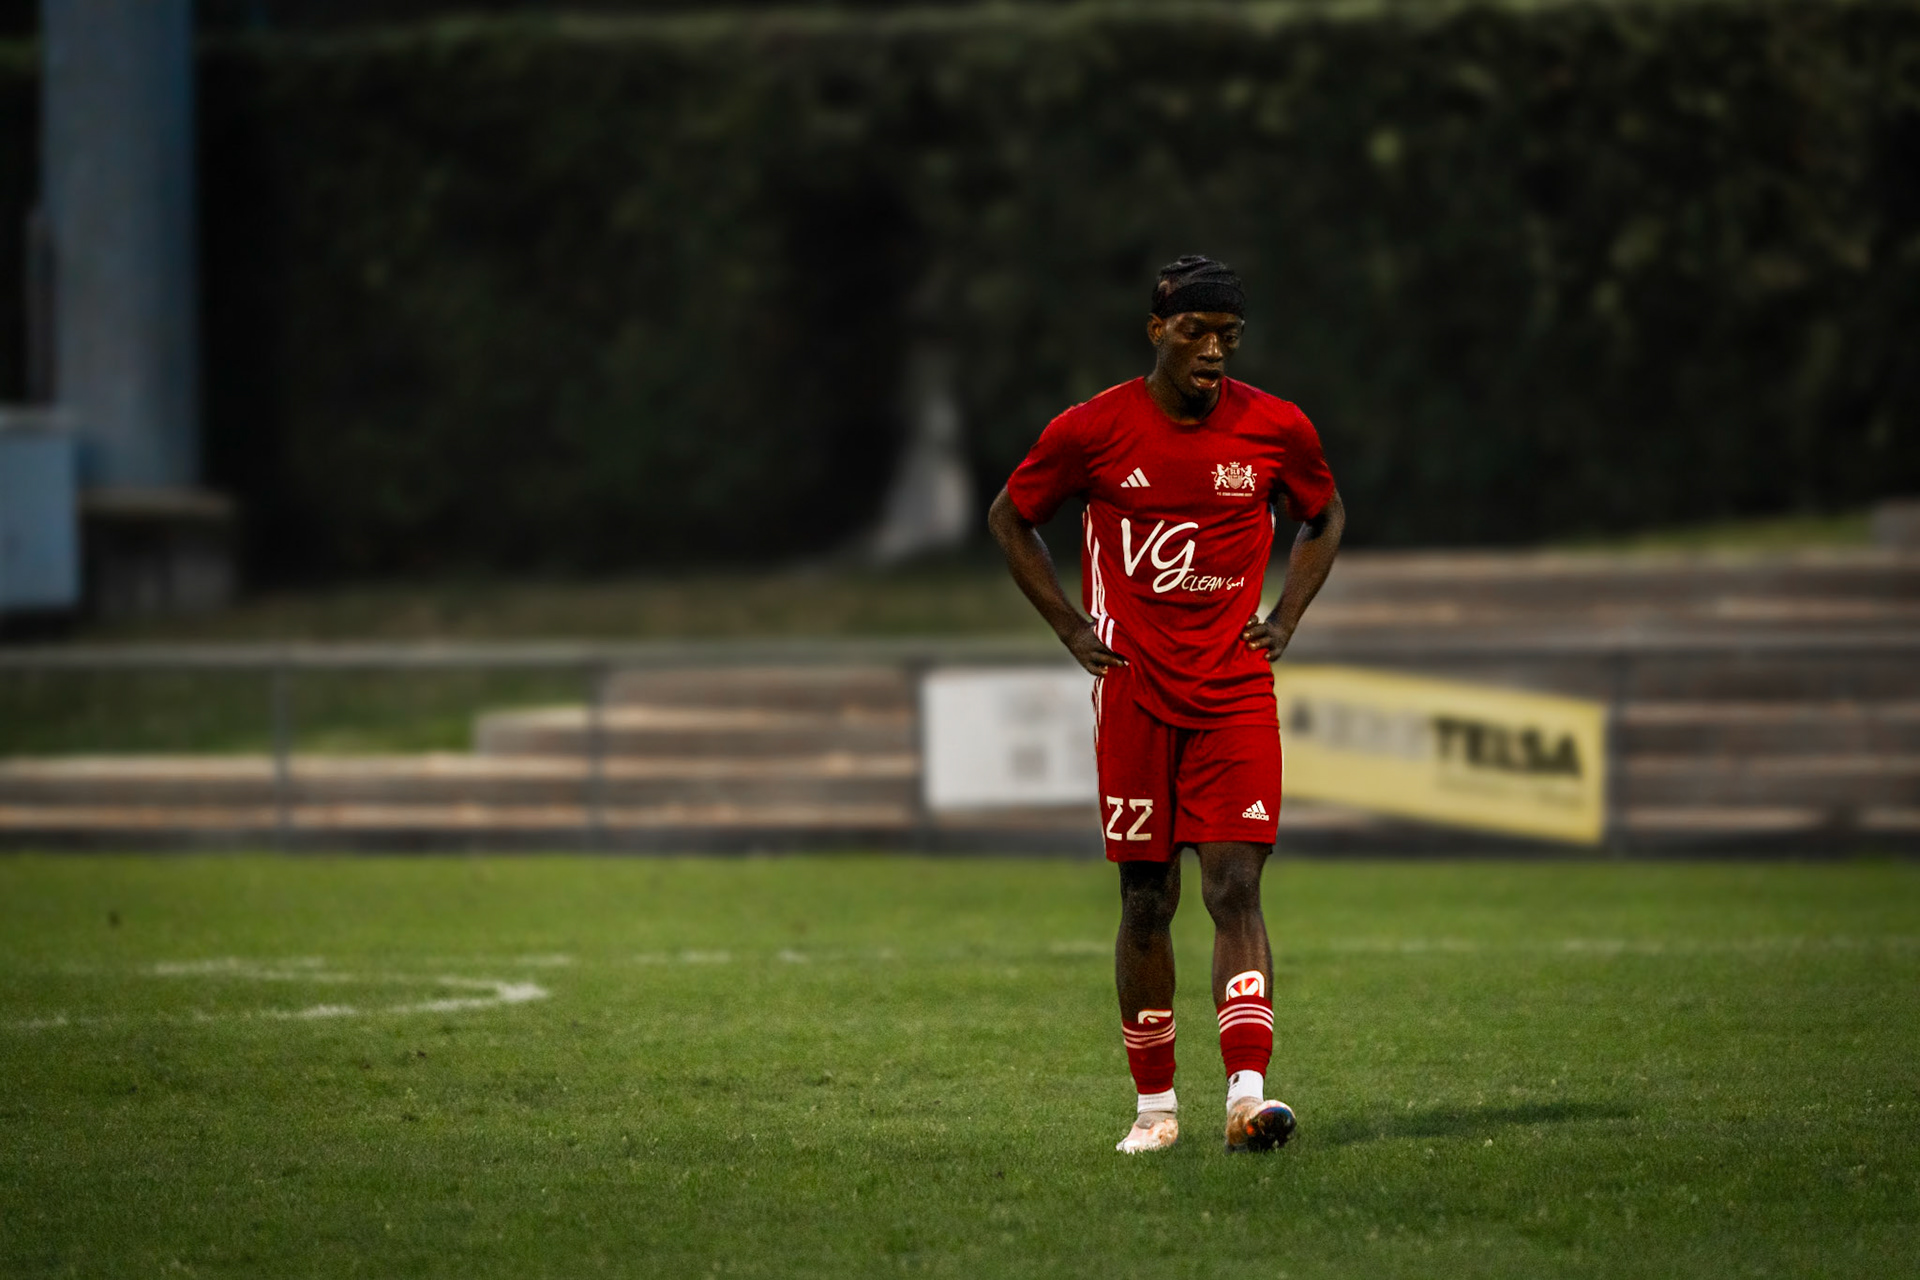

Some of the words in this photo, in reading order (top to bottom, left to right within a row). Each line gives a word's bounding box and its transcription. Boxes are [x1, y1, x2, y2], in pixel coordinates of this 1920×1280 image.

[1181, 575, 1226, 592] CLEAN
[1434, 715, 1582, 778] TELSA
[1105, 795, 1154, 841] 22
[1242, 811, 1269, 821] adidas
